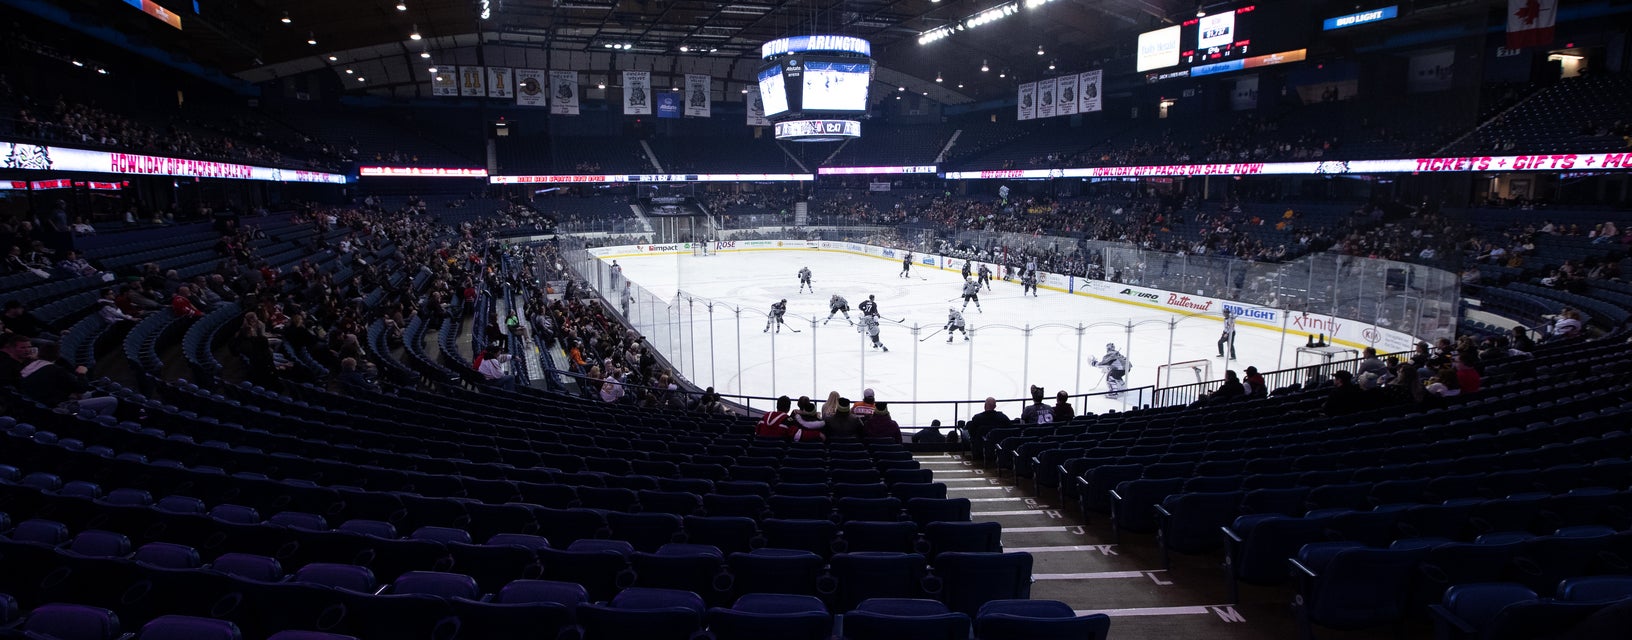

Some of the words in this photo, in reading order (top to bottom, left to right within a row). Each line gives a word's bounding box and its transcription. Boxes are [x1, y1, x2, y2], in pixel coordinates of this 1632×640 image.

[1336, 16, 1355, 26] BUD
[1355, 10, 1382, 22] LIGHT
[807, 35, 866, 54] ARLINGTON
[464, 71, 480, 88] 11
[496, 72, 504, 89] 1
[111, 152, 164, 174] HOWLIDAY
[167, 158, 185, 175] GIFT
[188, 160, 212, 177] PACKS
[214, 162, 222, 178] ON
[1092, 166, 1133, 176] HOWLIDAY
[1134, 166, 1153, 176] GIFT
[1155, 165, 1186, 176] PACKS
[1188, 164, 1201, 175] ON
[1204, 164, 1230, 175] SALE
[1233, 162, 1264, 174] NOW!
[1416, 156, 1492, 171] TICKETS
[1512, 154, 1578, 170] GIFTS
[654, 244, 678, 252] impact
[716, 241, 736, 250] ROSE
[1120, 288, 1159, 300] ATTURO
[1167, 292, 1213, 312] Butternut
[1224, 304, 1244, 316] BUD
[1245, 308, 1275, 320] LIGHT
[1294, 313, 1342, 336] xfinity
[1046, 510, 1062, 519] H
[1072, 525, 1085, 535] J
[1097, 544, 1119, 556] K
[1146, 572, 1174, 586] L
[1212, 606, 1246, 622] M
